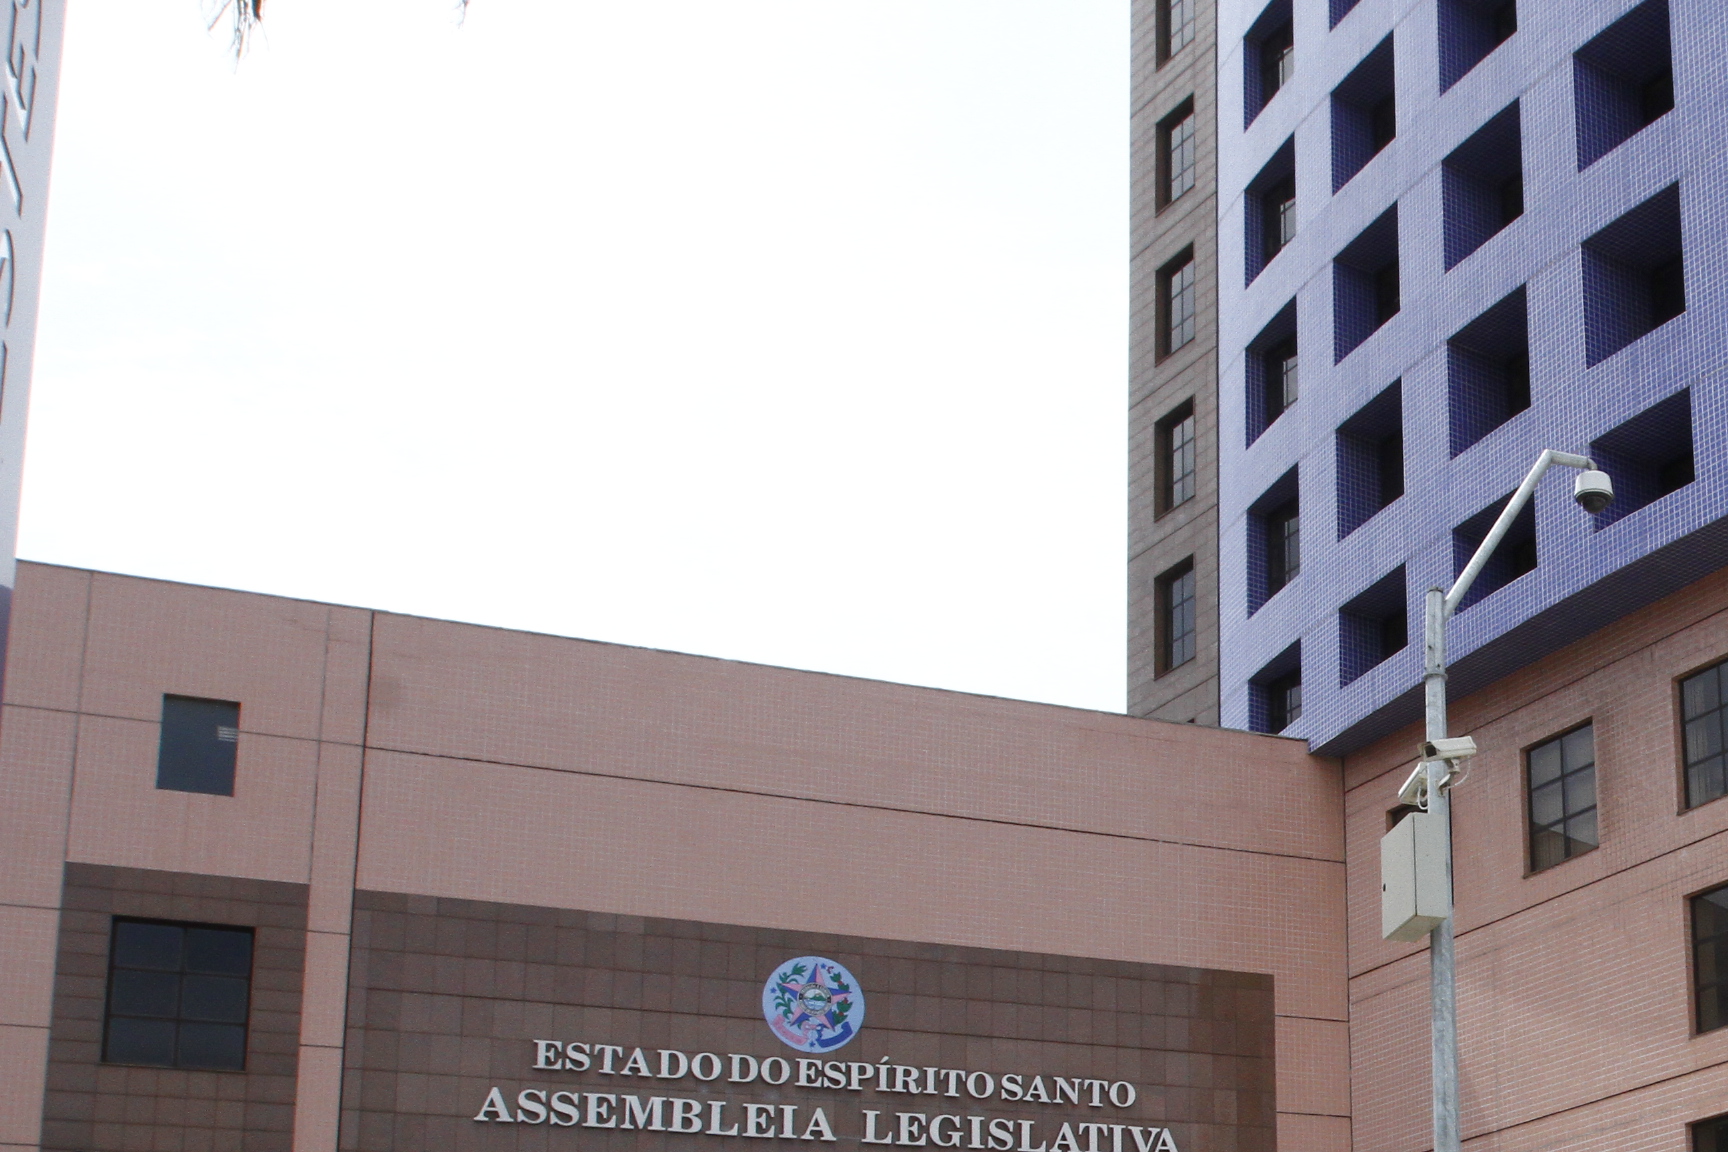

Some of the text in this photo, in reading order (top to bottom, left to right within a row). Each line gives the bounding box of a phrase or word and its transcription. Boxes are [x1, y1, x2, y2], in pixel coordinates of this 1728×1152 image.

[532, 1038, 1136, 1109] ESTADO DO ESPÍRITO SANTO
[473, 1086, 837, 1142] ASSEMBLEIA
